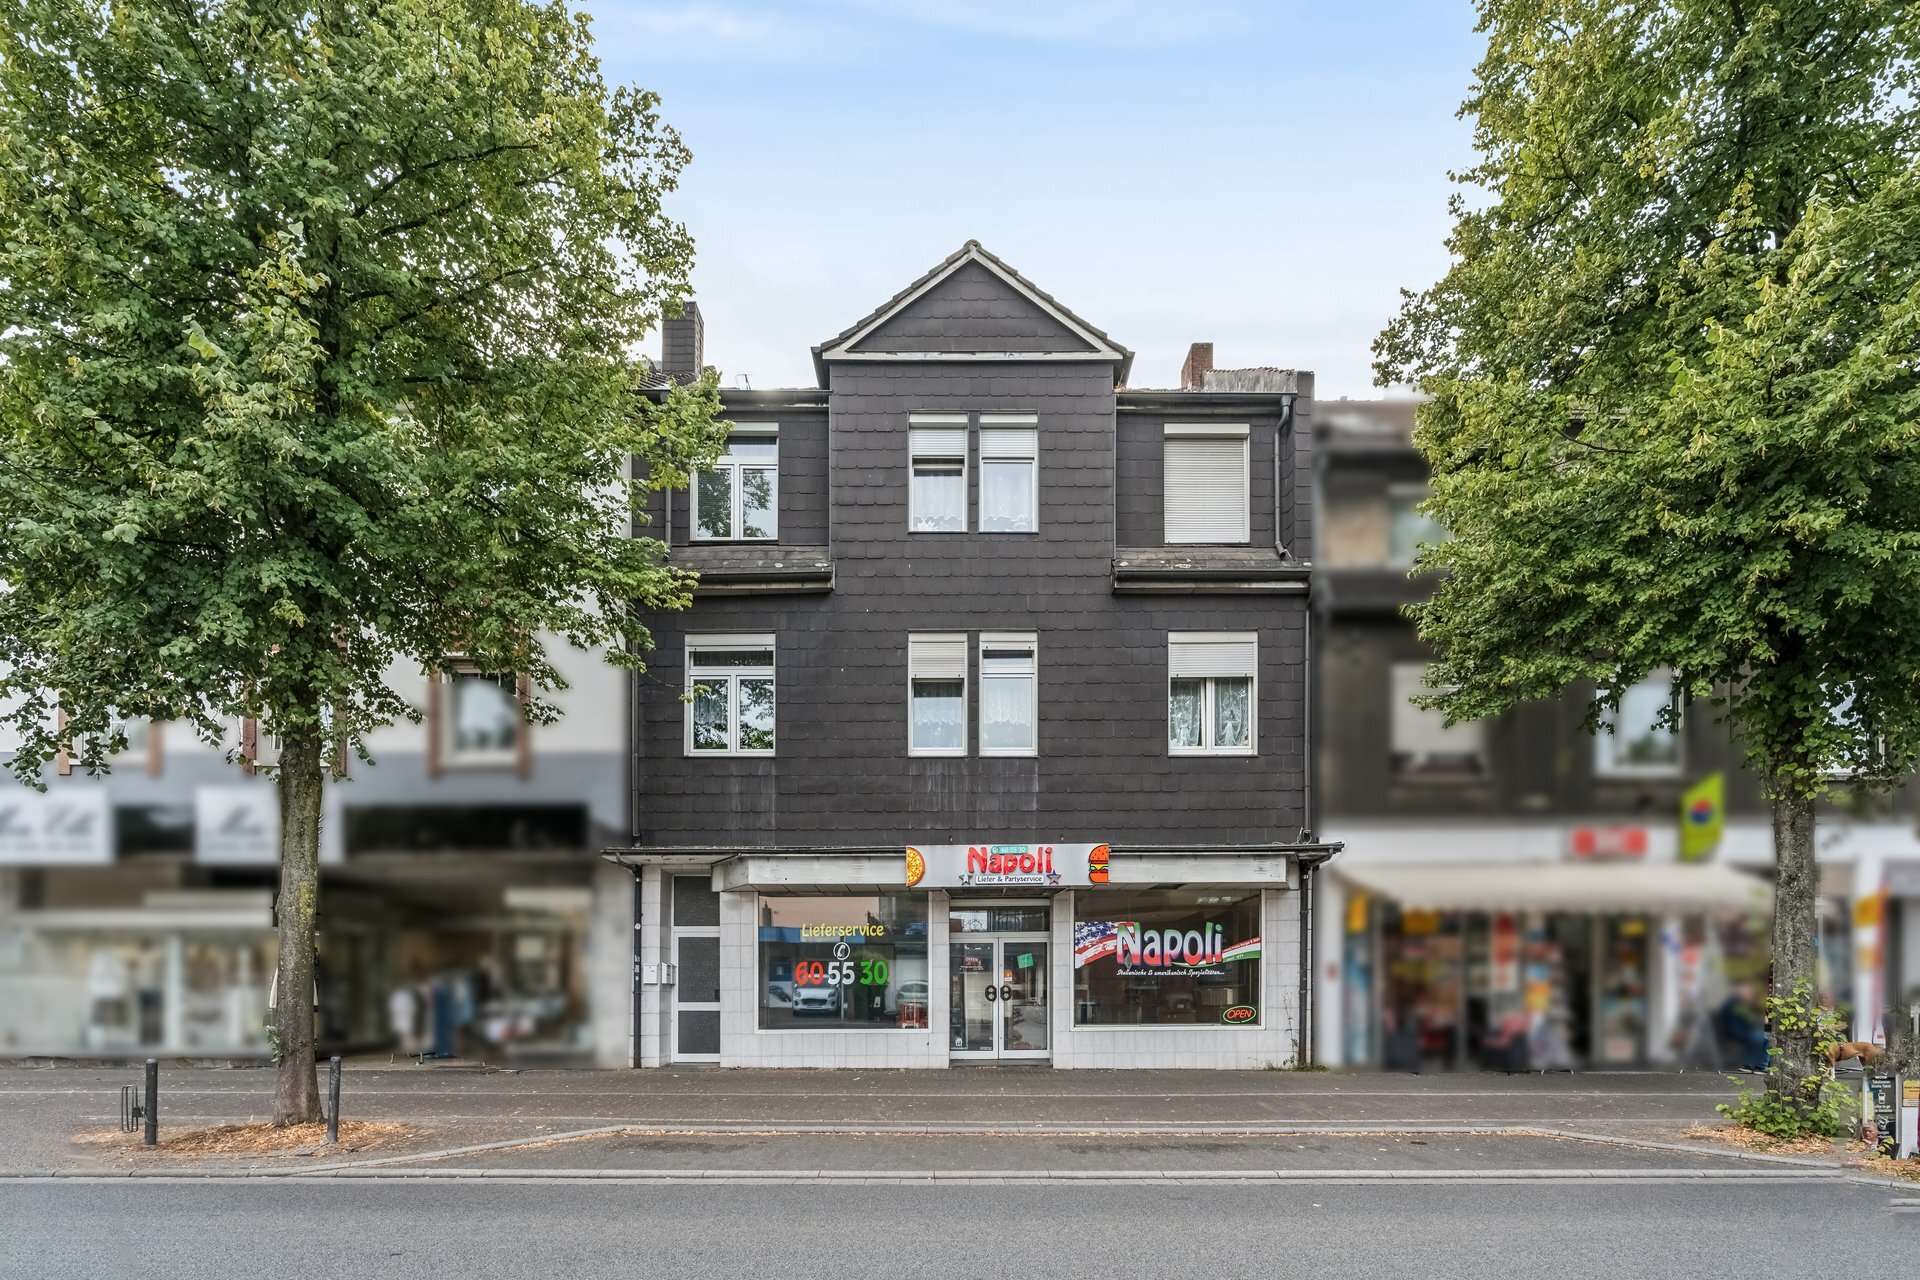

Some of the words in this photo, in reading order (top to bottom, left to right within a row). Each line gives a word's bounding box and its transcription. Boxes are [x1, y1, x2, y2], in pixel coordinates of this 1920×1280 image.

[967, 846, 1053, 876] Napoli
[800, 923, 885, 937] Lieferservice
[1117, 922, 1224, 968] Napoli
[794, 960, 825, 985] 60
[827, 961, 855, 985] 55
[859, 959, 889, 985] 30
[1226, 1009, 1253, 1020] OPEN
